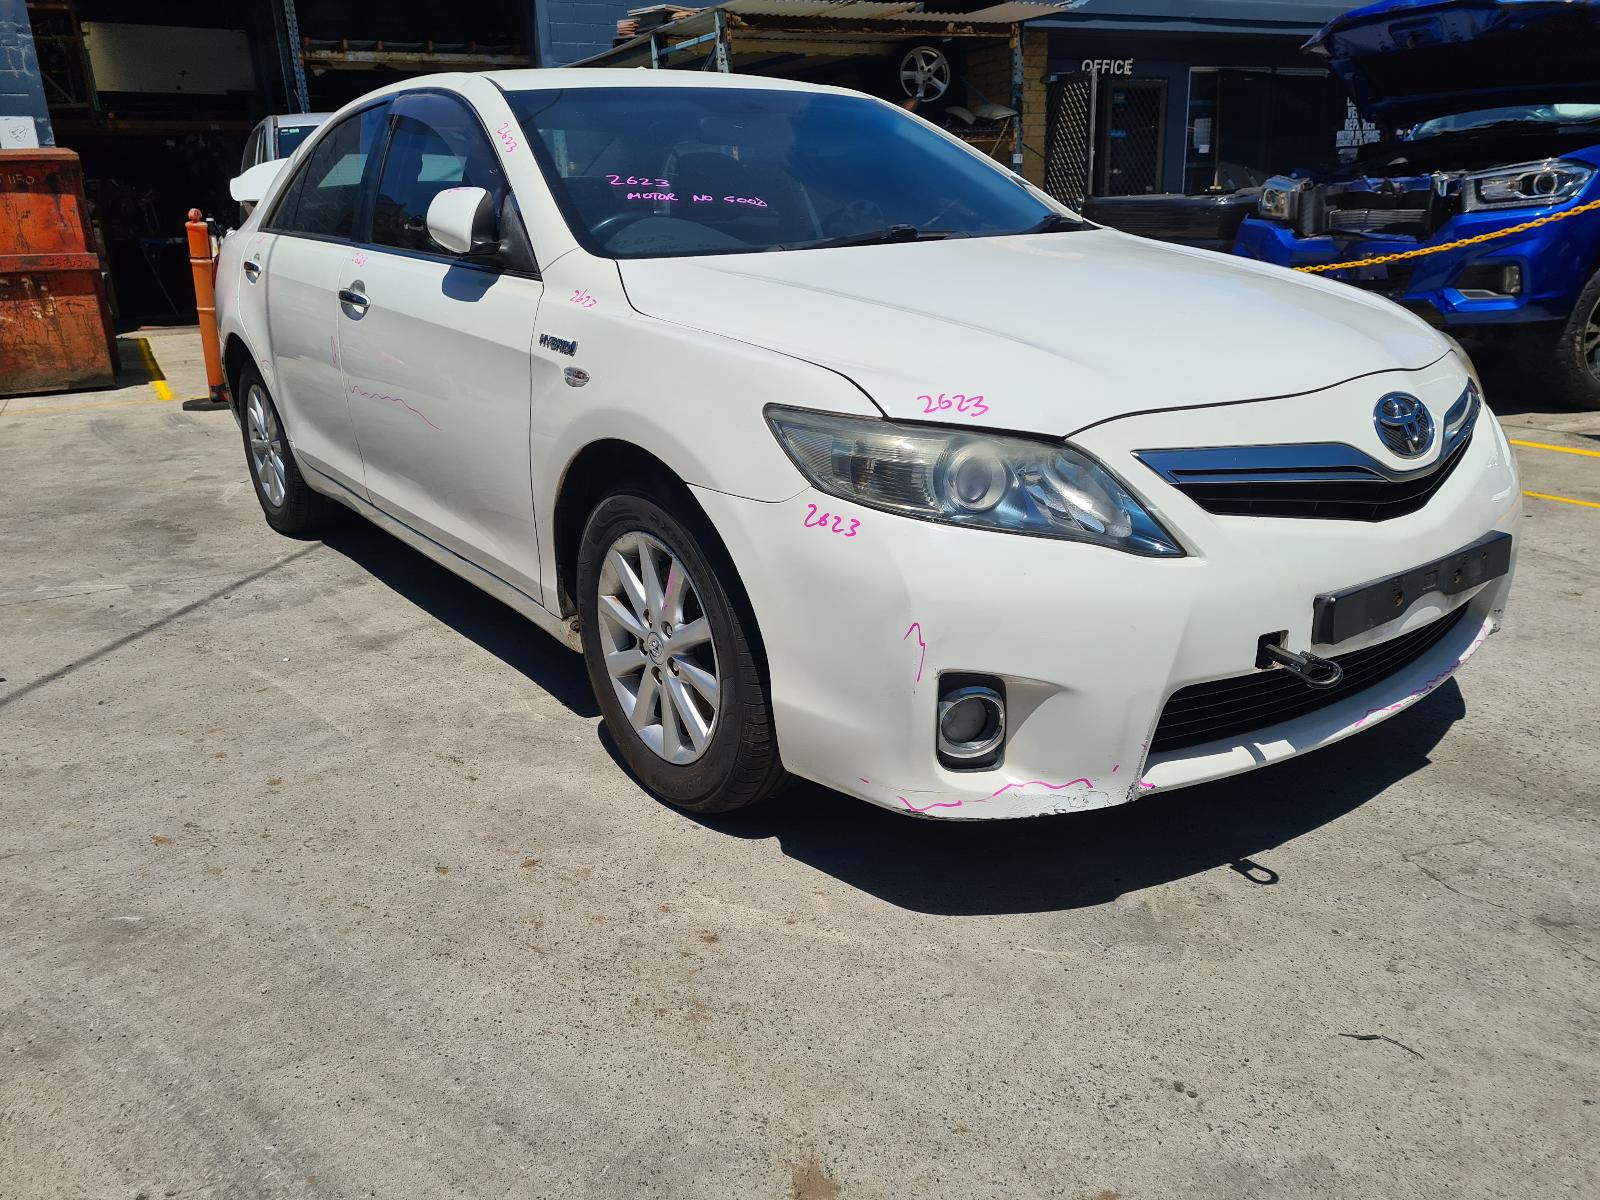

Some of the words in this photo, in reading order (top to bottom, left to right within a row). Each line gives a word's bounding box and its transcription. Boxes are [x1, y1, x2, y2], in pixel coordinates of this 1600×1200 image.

[1081, 58, 1134, 75] OFFICE
[497, 122, 517, 153] 2623
[605, 174, 671, 187] 2623
[626, 191, 679, 202] MOTOR
[692, 193, 713, 203] NO
[569, 286, 598, 309] 2623
[538, 333, 579, 357] HYBRID
[916, 392, 990, 418] 2623
[803, 502, 862, 537] 2623
